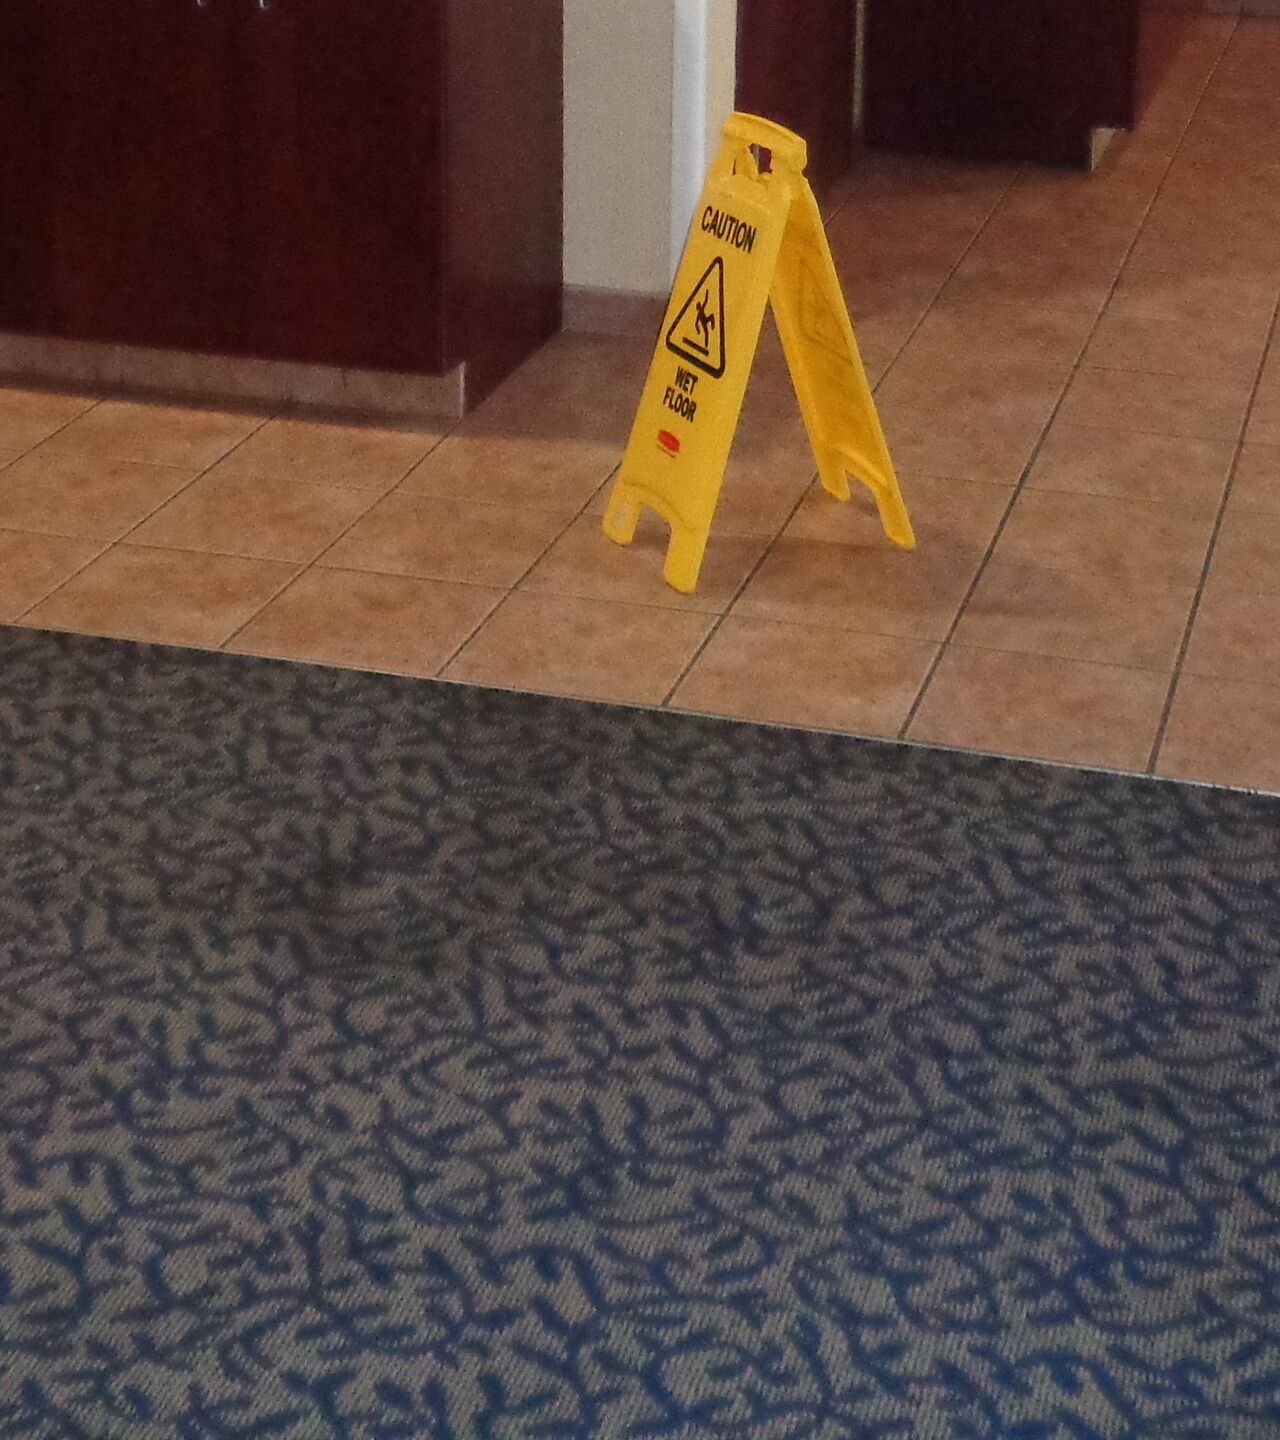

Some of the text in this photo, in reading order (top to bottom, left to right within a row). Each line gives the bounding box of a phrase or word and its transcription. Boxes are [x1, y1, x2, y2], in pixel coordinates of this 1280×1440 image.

[701, 205, 757, 254] CAUTION
[675, 366, 698, 395] WET
[663, 386, 697, 423] FLOOR
